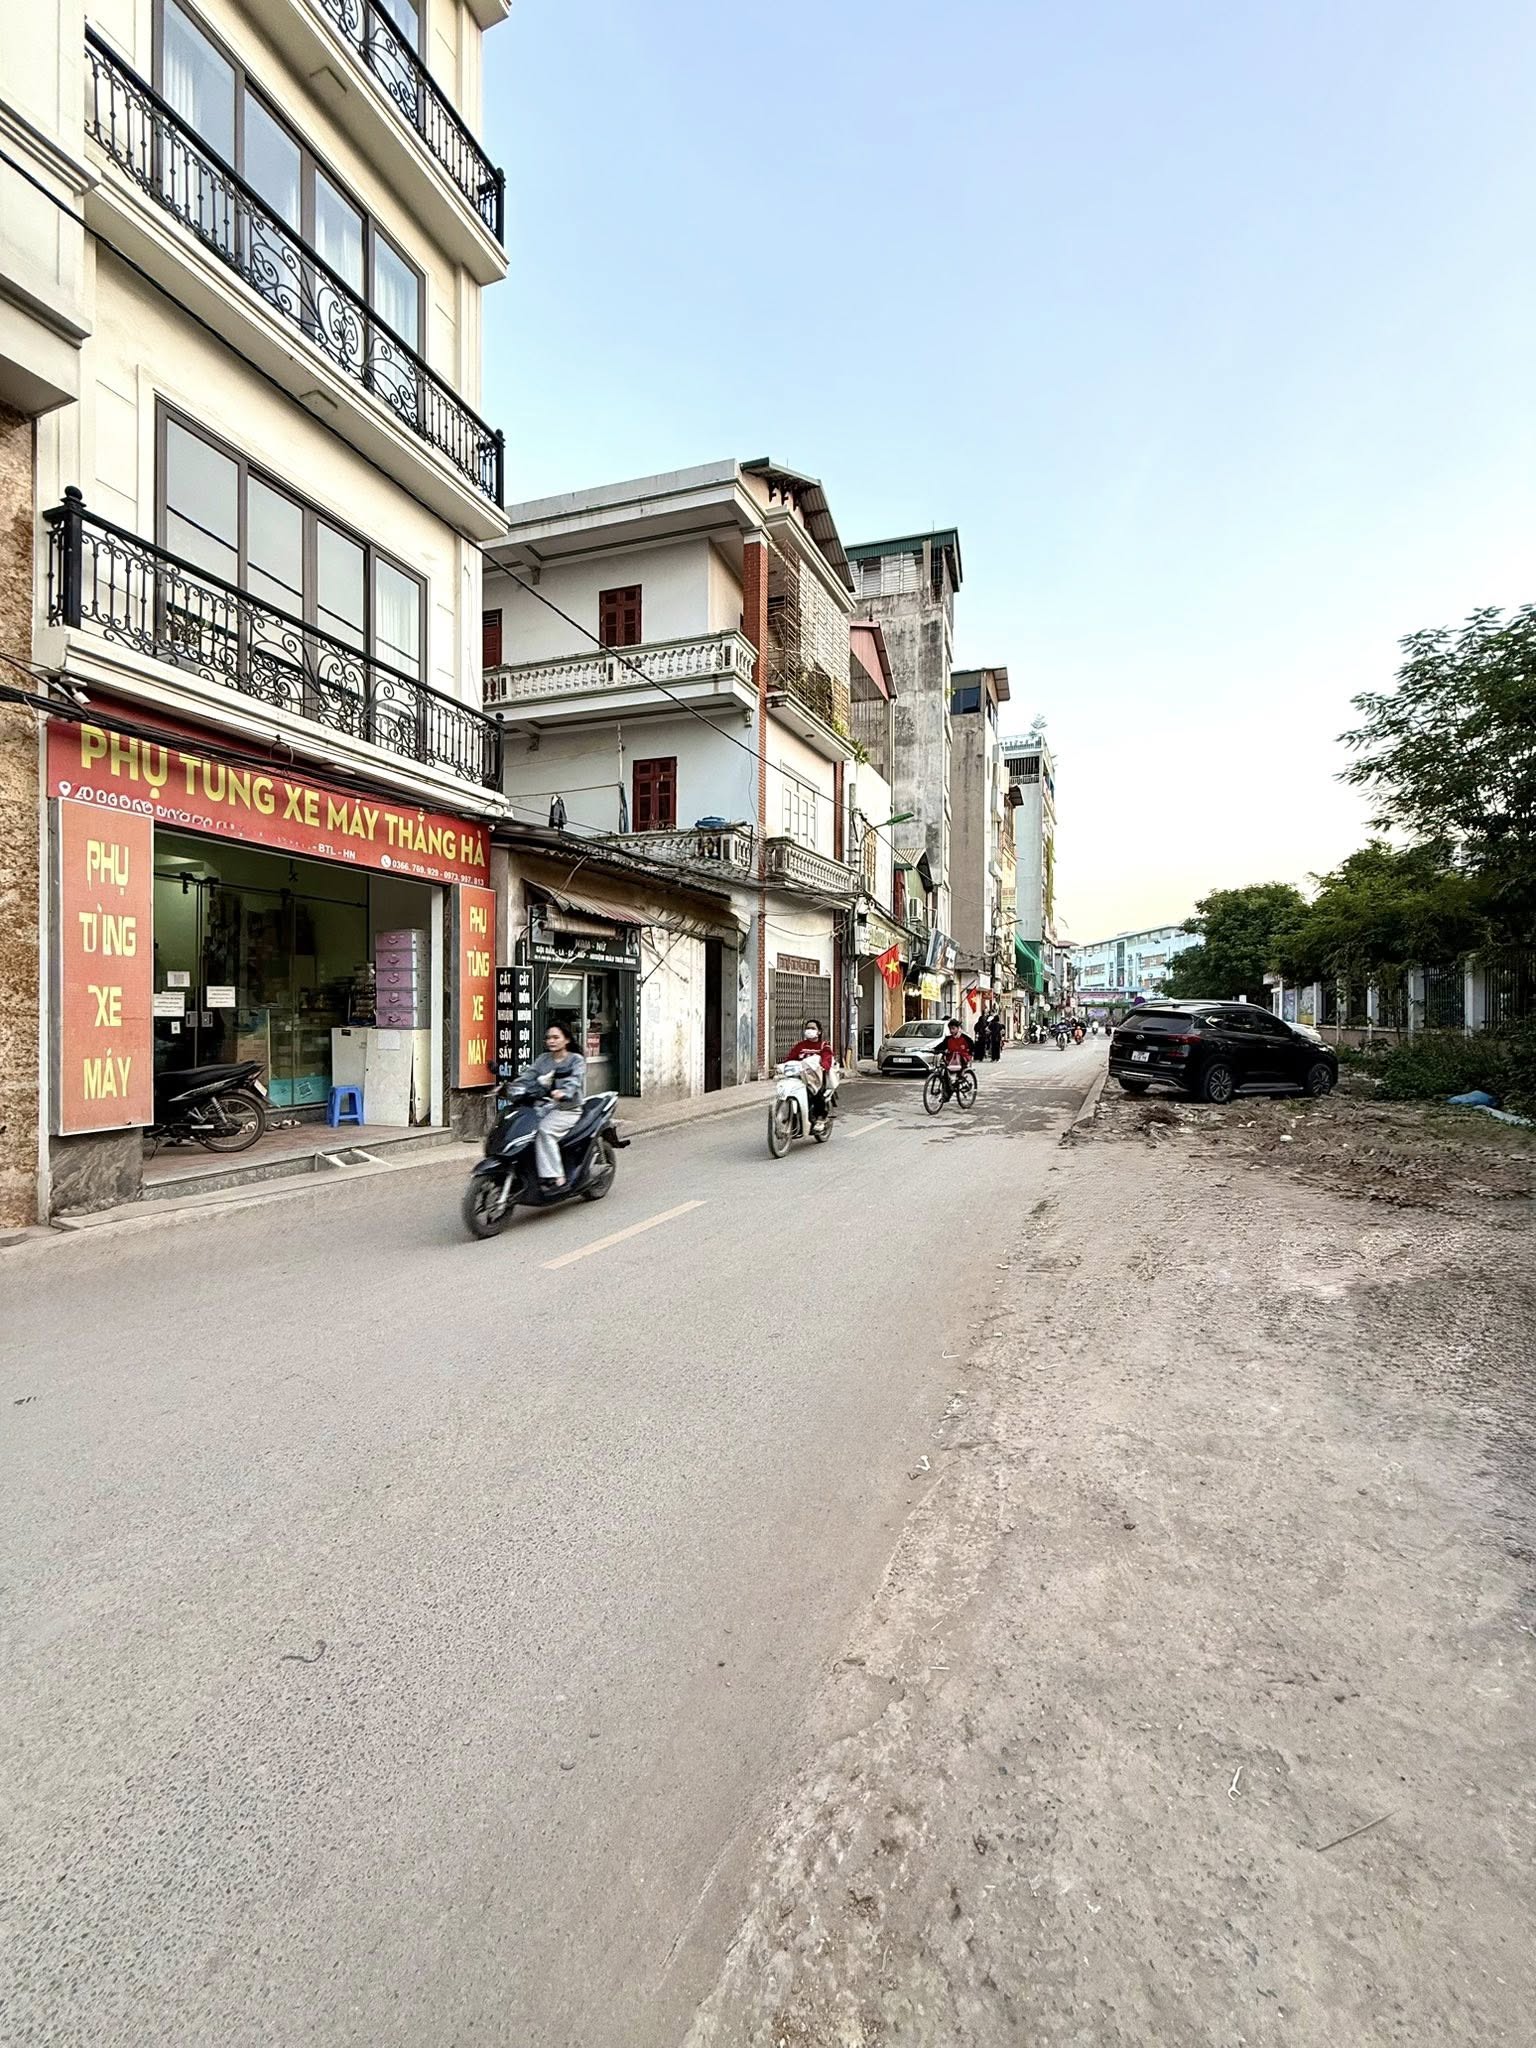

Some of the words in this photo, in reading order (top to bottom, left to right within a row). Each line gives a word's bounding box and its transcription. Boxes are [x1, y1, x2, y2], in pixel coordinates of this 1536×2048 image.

[81, 723, 168, 799] PHỤ
[283, 783, 320, 827] XE
[327, 799, 379, 841] MÁY
[460, 830, 486, 867] HÀ
[318, 843, 336, 856] BTL
[343, 848, 356, 860] HN
[86, 840, 129, 896] PHỤ
[78, 902, 137, 957] TÙNG
[469, 906, 487, 940] PHỤ
[466, 947, 490, 977] TÙNG
[87, 985, 122, 1027] XE
[472, 995, 484, 1021] XE
[467, 1034, 488, 1066] MÁY
[500, 1027, 512, 1043] GỘI
[519, 1027, 530, 1043] GỘI
[498, 1044, 512, 1059] SẤY
[83, 1047, 132, 1100] MÁY
